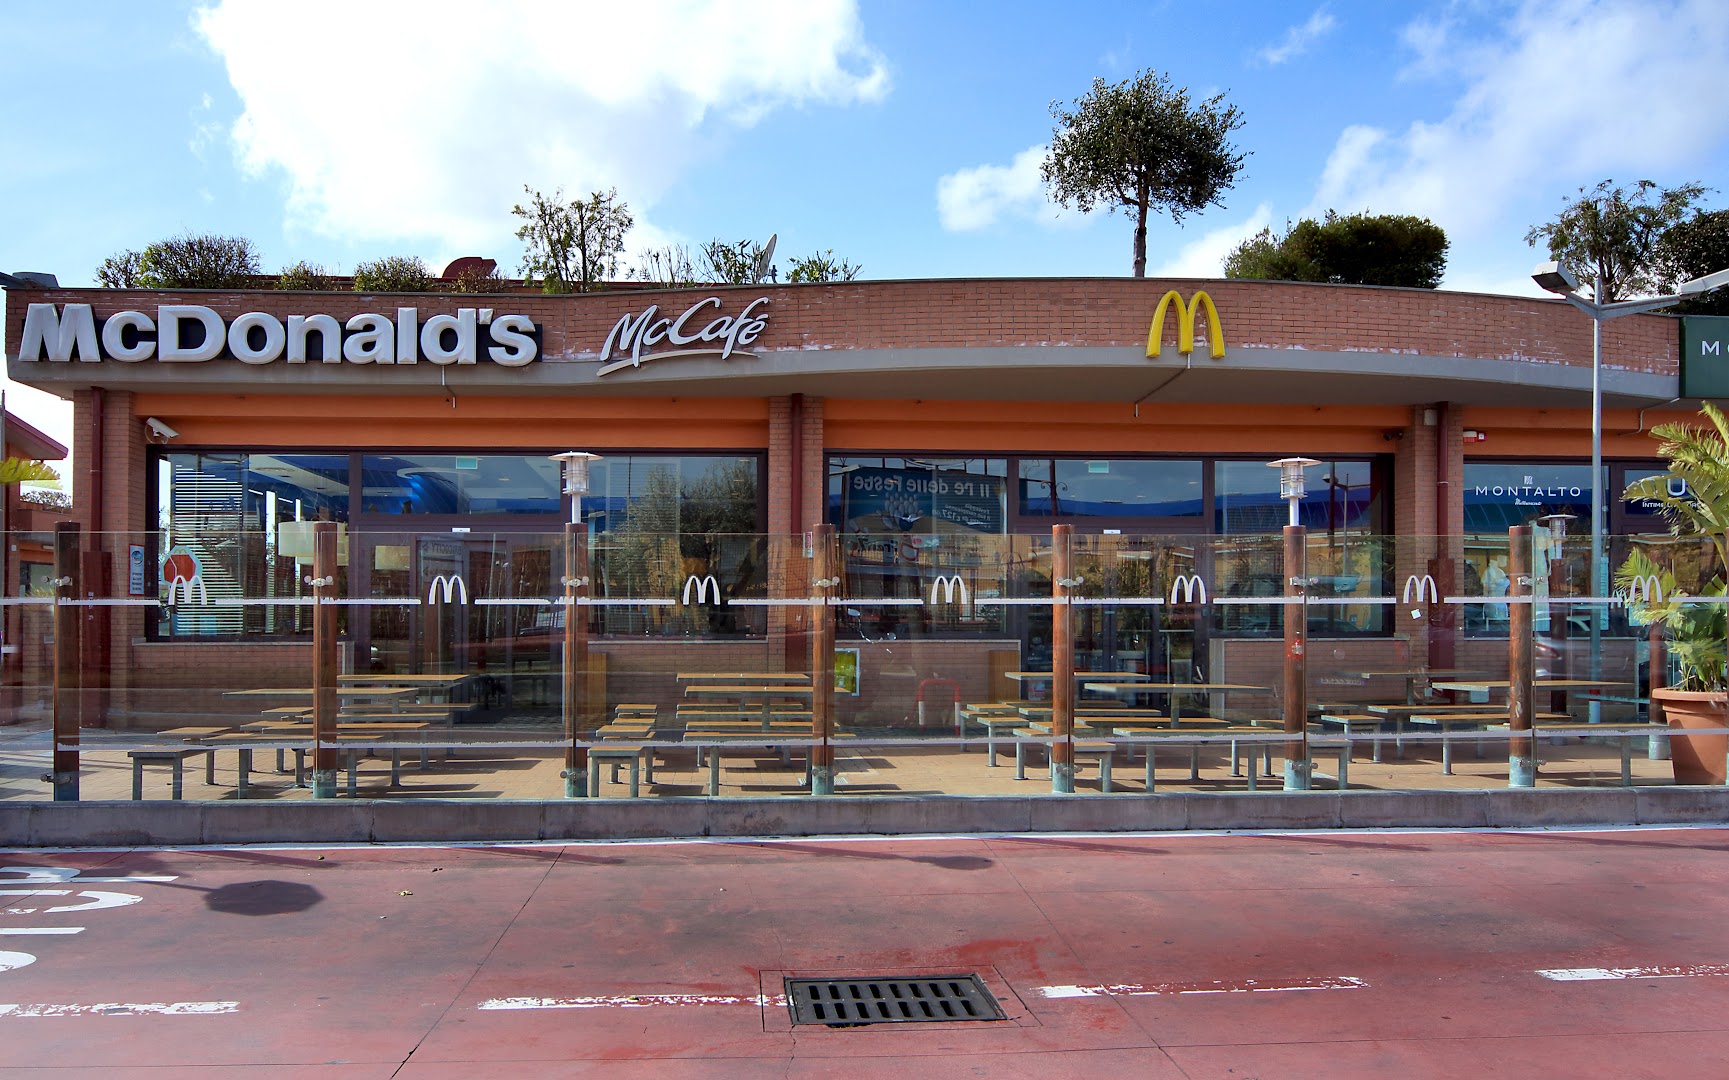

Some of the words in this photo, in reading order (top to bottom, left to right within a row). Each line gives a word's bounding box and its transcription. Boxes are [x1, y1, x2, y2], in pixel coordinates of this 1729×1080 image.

[18, 302, 537, 367] McDonald's
[600, 297, 770, 367] McCafé
[1475, 485, 1581, 497] MONTALTO
